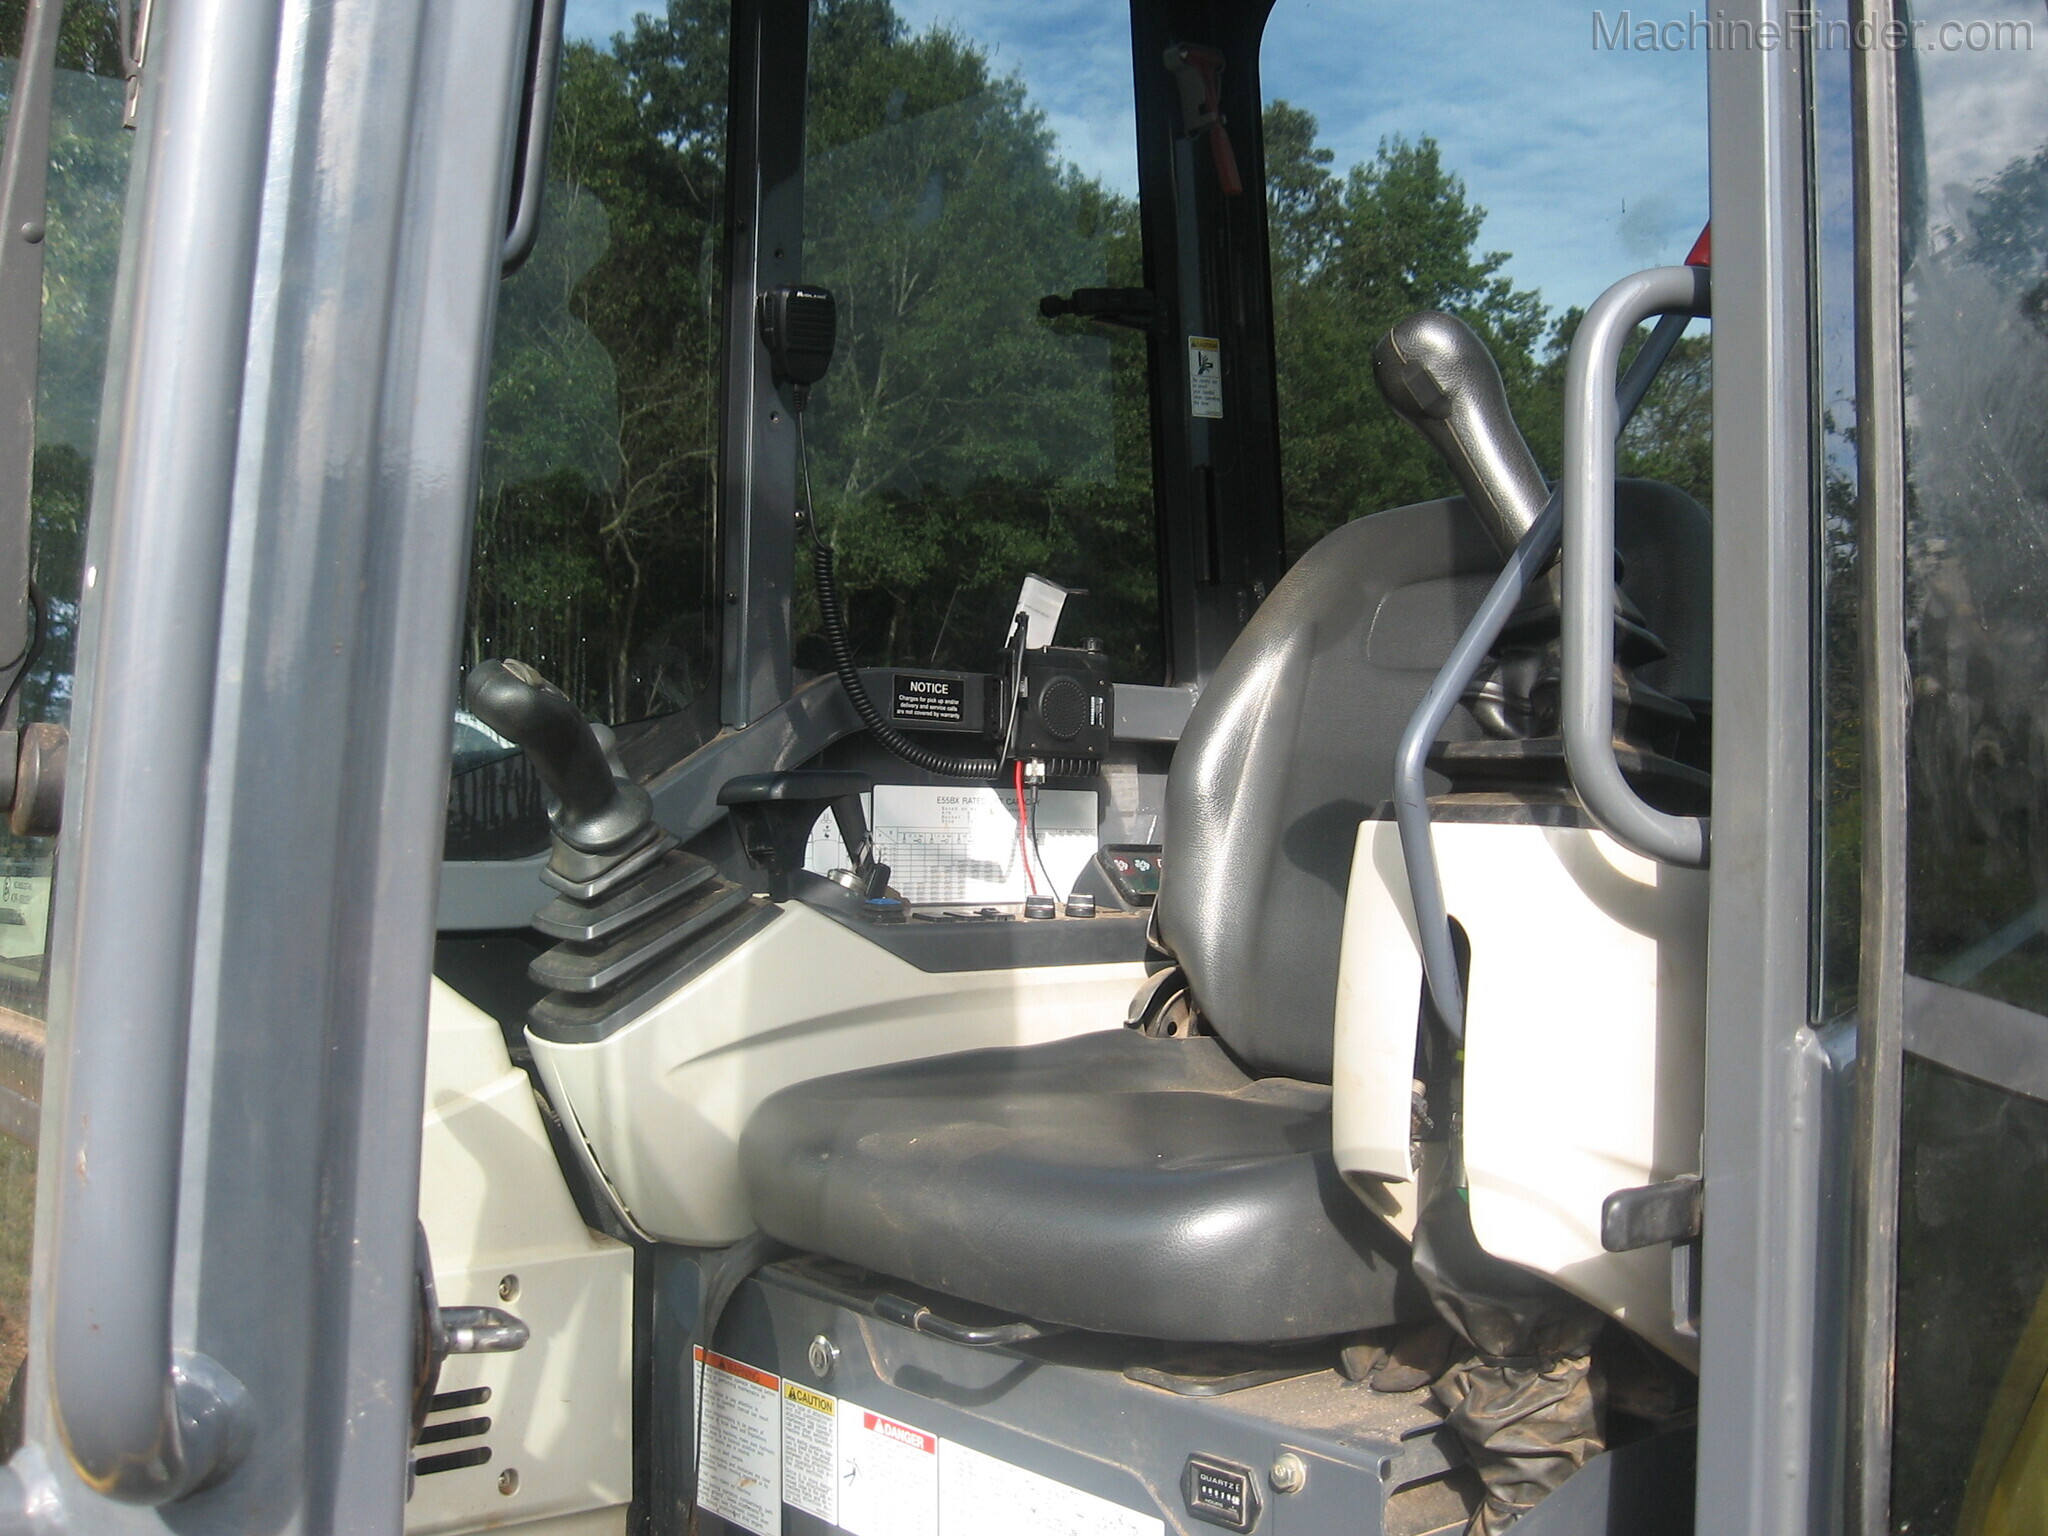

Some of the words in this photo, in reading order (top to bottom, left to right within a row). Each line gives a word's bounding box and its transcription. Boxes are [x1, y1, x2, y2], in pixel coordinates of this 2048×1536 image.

[910, 681, 949, 695] NOTICE
[898, 694, 919, 702] Charges
[796, 1390, 833, 1413] CAUTION
[884, 1422, 925, 1450] DANGER
